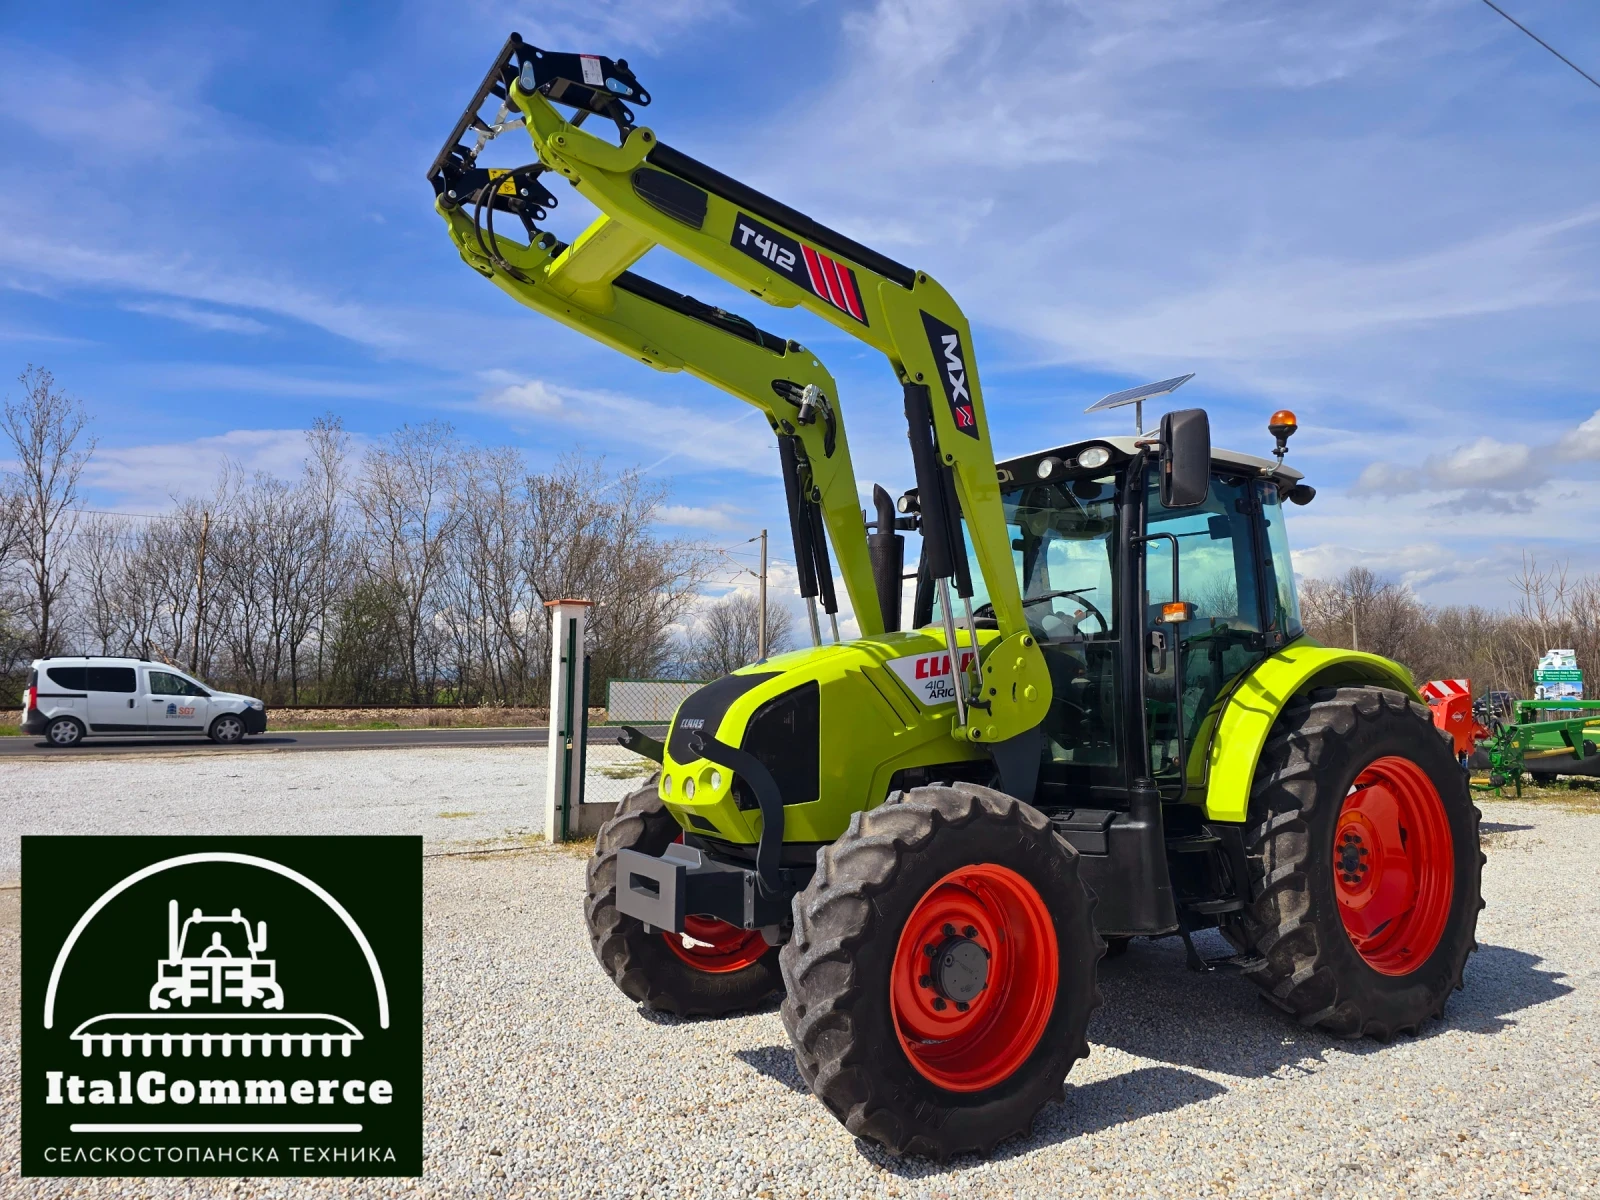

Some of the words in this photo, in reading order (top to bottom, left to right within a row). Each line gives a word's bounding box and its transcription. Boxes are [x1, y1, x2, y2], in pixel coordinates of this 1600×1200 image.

[739, 223, 796, 272] T412
[941, 334, 970, 402] MX
[925, 680, 945, 691] 410
[178, 706, 196, 715] SG7
